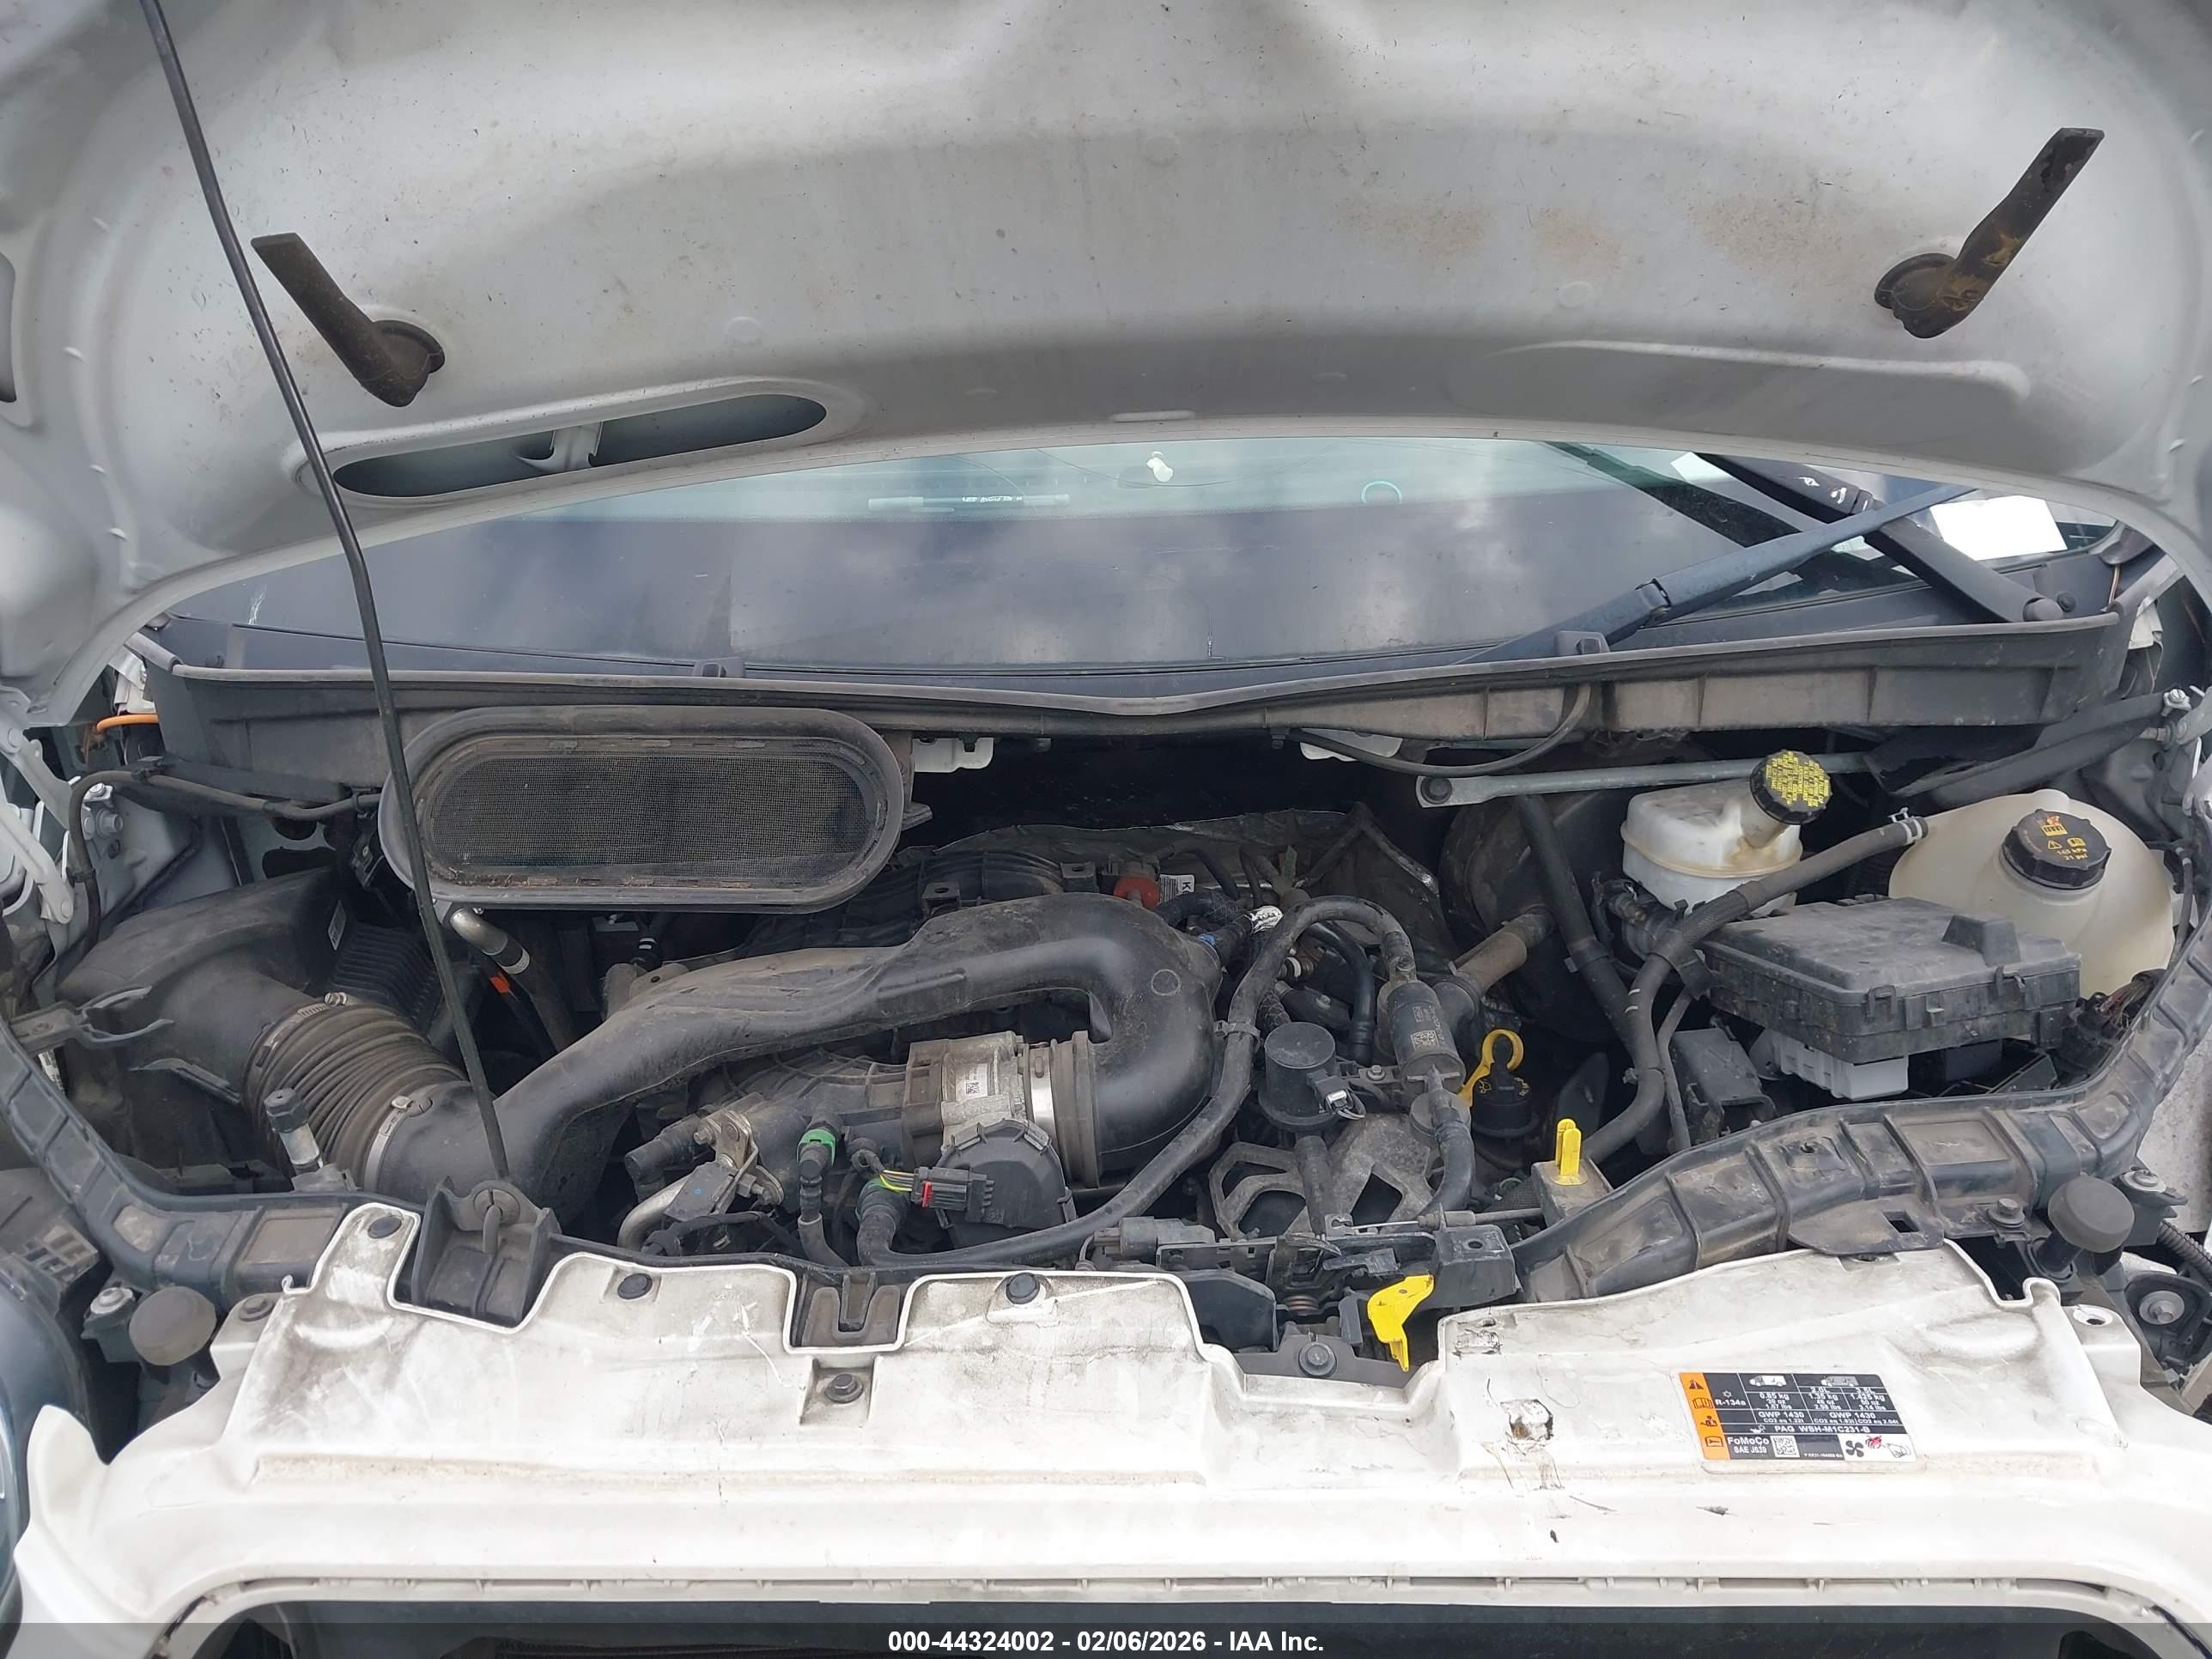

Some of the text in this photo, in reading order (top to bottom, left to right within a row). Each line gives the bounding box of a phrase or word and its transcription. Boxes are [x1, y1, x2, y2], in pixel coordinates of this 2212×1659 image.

[1778, 1392, 1790, 1401] kg
[1826, 1393, 1838, 1401] kg
[1874, 1394, 1886, 1402] kg
[1727, 1436, 1770, 1446] FoMoCo
